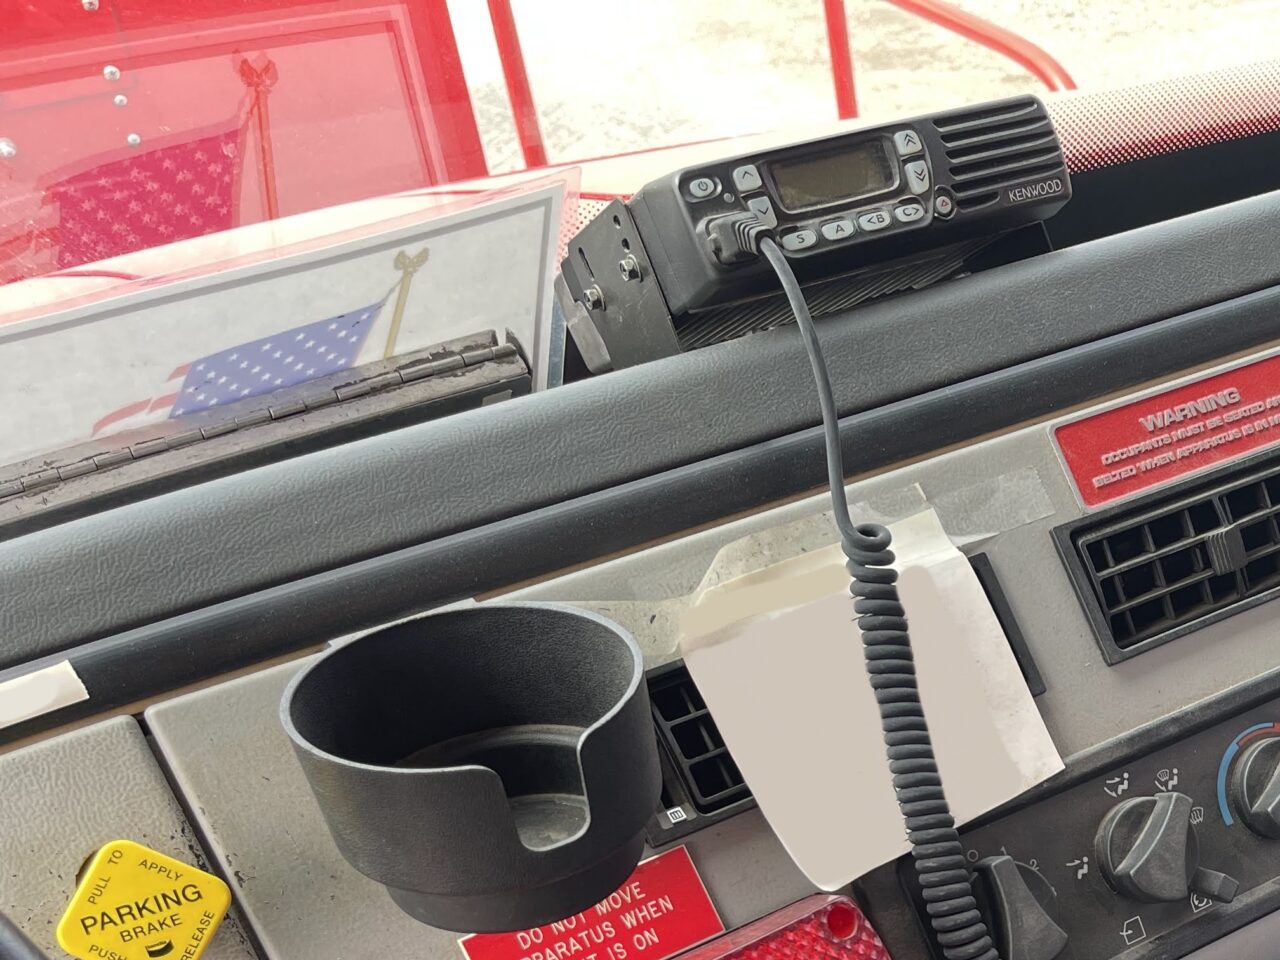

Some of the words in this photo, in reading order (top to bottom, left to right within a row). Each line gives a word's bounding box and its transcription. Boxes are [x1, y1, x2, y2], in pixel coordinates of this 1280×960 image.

[1008, 178, 1062, 204] KENWOOD
[794, 233, 806, 245] S
[834, 224, 846, 235] A
[1138, 386, 1241, 432] WARNING
[1101, 434, 1173, 465] OCCUPANTS
[1171, 421, 1206, 442] MUST
[1207, 415, 1224, 430] BE
[1223, 401, 1266, 423] SEATED
[1091, 466, 1138, 489] BELTED
[1137, 453, 1176, 472] WHEN
[1176, 429, 1242, 459] APPARATUS
[1243, 424, 1256, 437] IS
[1255, 419, 1270, 432] IN
[87, 875, 111, 905] PULL
[107, 849, 123, 866] TO
[138, 858, 184, 882] APPLY
[79, 883, 204, 936] PARKING
[119, 913, 184, 943] BRAKE
[516, 927, 544, 950] DO
[595, 881, 646, 916] MOVE
[620, 895, 675, 929] WHEN
[633, 928, 660, 950] ON
